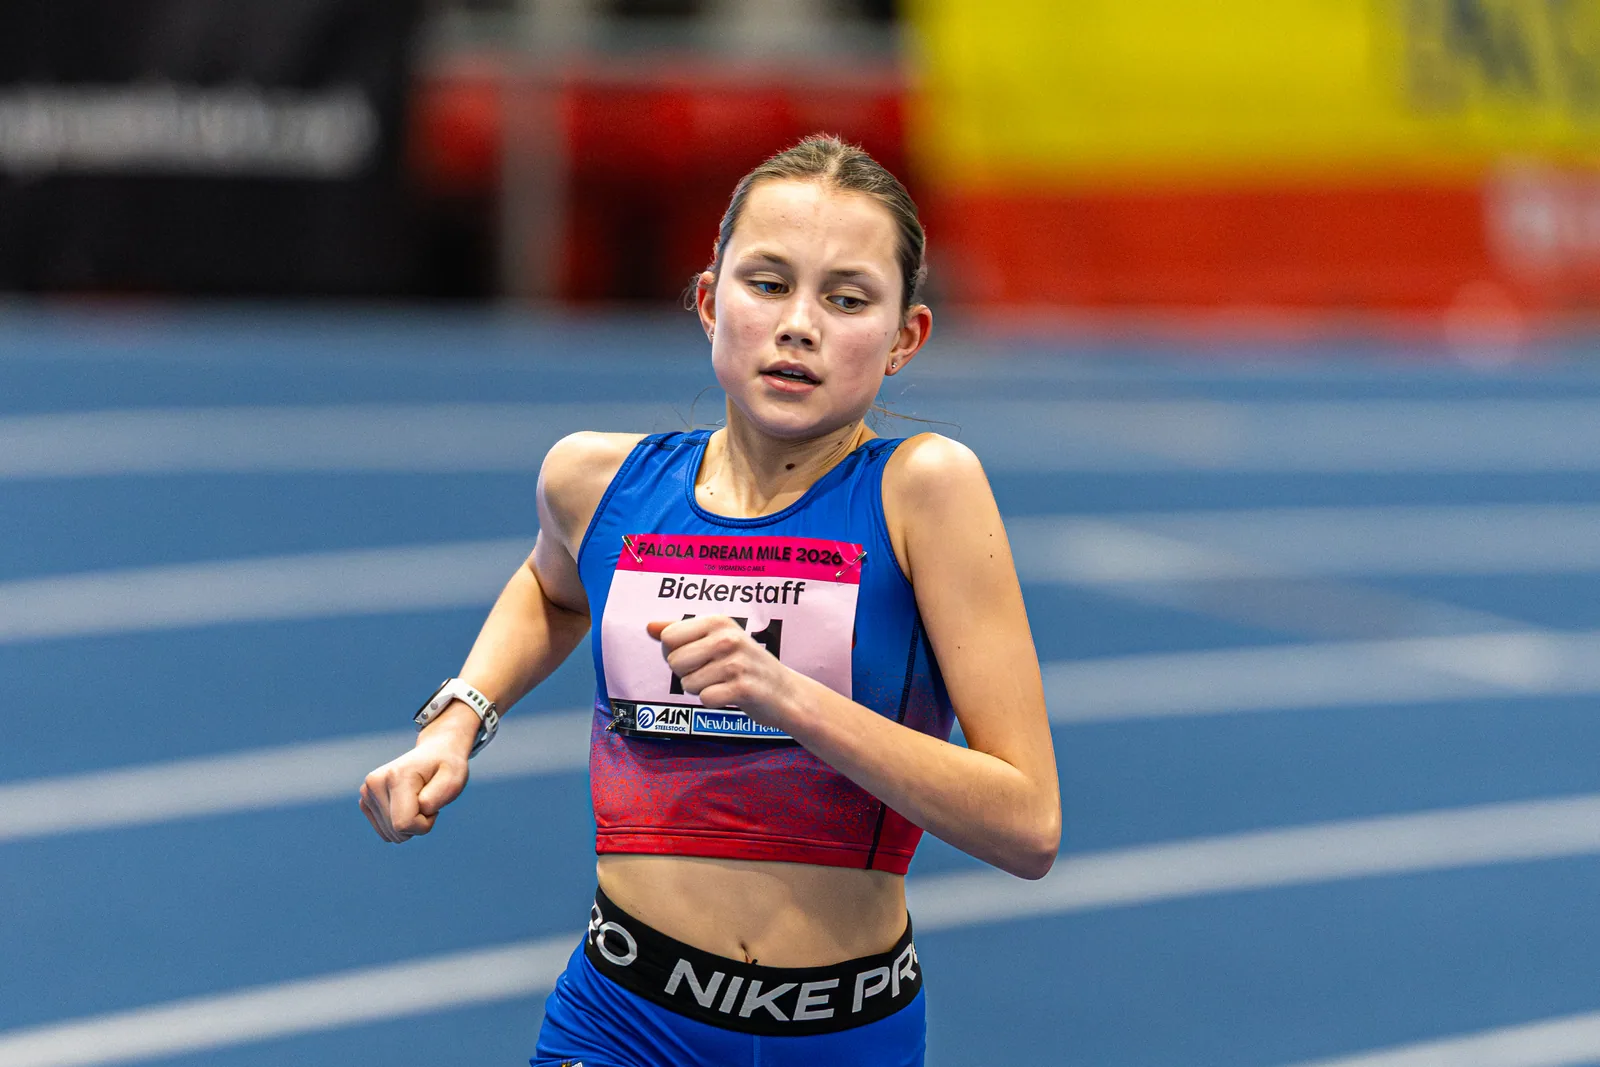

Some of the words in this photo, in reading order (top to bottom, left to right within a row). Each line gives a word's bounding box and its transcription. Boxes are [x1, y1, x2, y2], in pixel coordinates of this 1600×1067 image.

[637, 541, 694, 559] FALOLA
[698, 544, 753, 561] DREAM
[756, 546, 791, 561] MILE
[795, 547, 843, 566] 2026
[718, 564, 746, 572] WOMENS
[657, 576, 806, 605] Bickerstaff
[656, 708, 690, 725] AJN
[655, 724, 686, 732] STEELSTOCK
[664, 957, 840, 1022] NIKE
[851, 941, 918, 1014] PR
